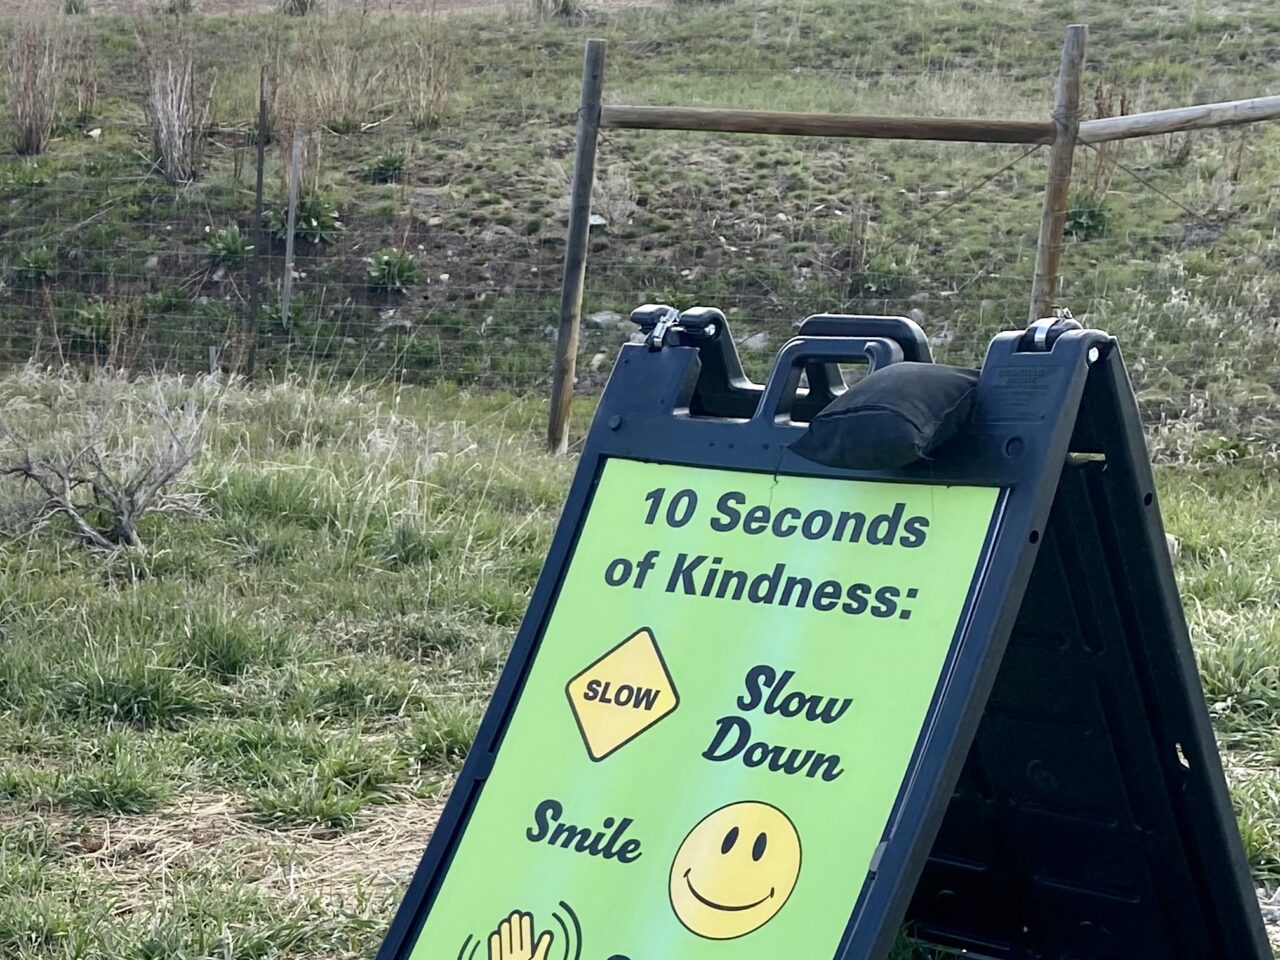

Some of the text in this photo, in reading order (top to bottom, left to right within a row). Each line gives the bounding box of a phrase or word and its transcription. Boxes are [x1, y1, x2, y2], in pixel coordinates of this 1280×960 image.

[644, 488, 930, 548] 10 Seconds
[605, 550, 919, 620] of Kindness:
[583, 679, 661, 711] SLOW
[737, 665, 854, 724] Slow
[702, 716, 845, 782] Down
[526, 800, 642, 864] Smile
